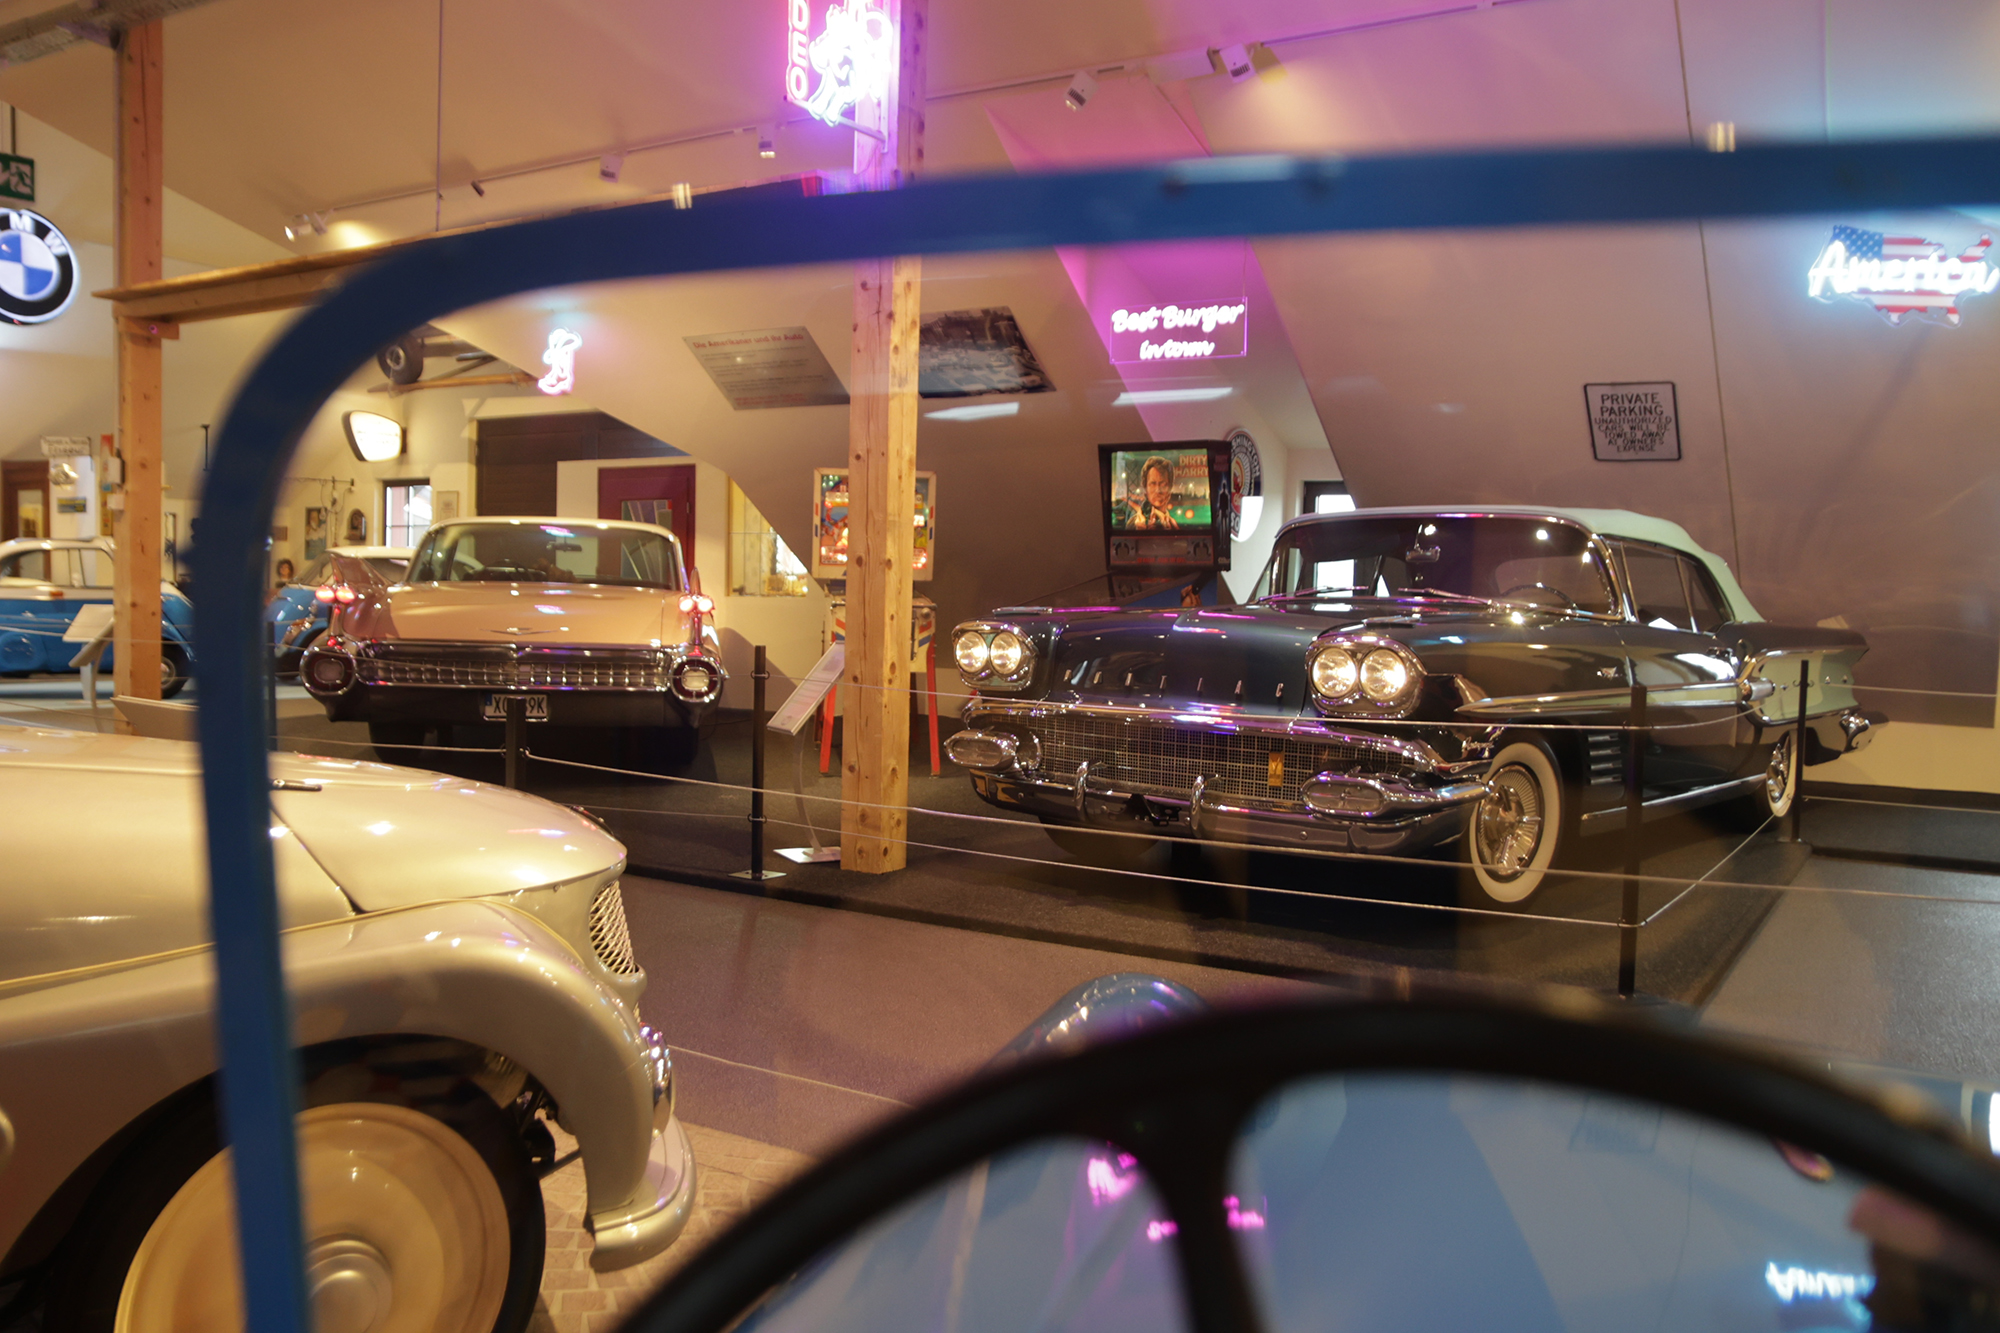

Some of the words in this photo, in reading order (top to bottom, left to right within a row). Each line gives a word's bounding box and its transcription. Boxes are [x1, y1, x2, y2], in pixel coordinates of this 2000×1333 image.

[789, 0, 808, 100] DEO
[9, 211, 69, 257] MW
[1808, 239, 2000, 297] America
[1111, 306, 1161, 333] Best
[1161, 304, 1245, 333] Burger
[1601, 393, 1660, 405] PRIVATE
[1600, 405, 1664, 417] PARKING
[1594, 416, 1672, 425] UNAUTHORIZED
[1629, 424, 1652, 432] WILL
[1657, 423, 1670, 431] BE
[1604, 431, 1637, 439] TOWED
[1642, 430, 1666, 438] AWAY
[1608, 438, 1619, 446] AT
[1617, 445, 1656, 453] EXPENSE
[1179, 455, 1208, 466] DIRTY
[1174, 466, 1209, 477] HARRY
